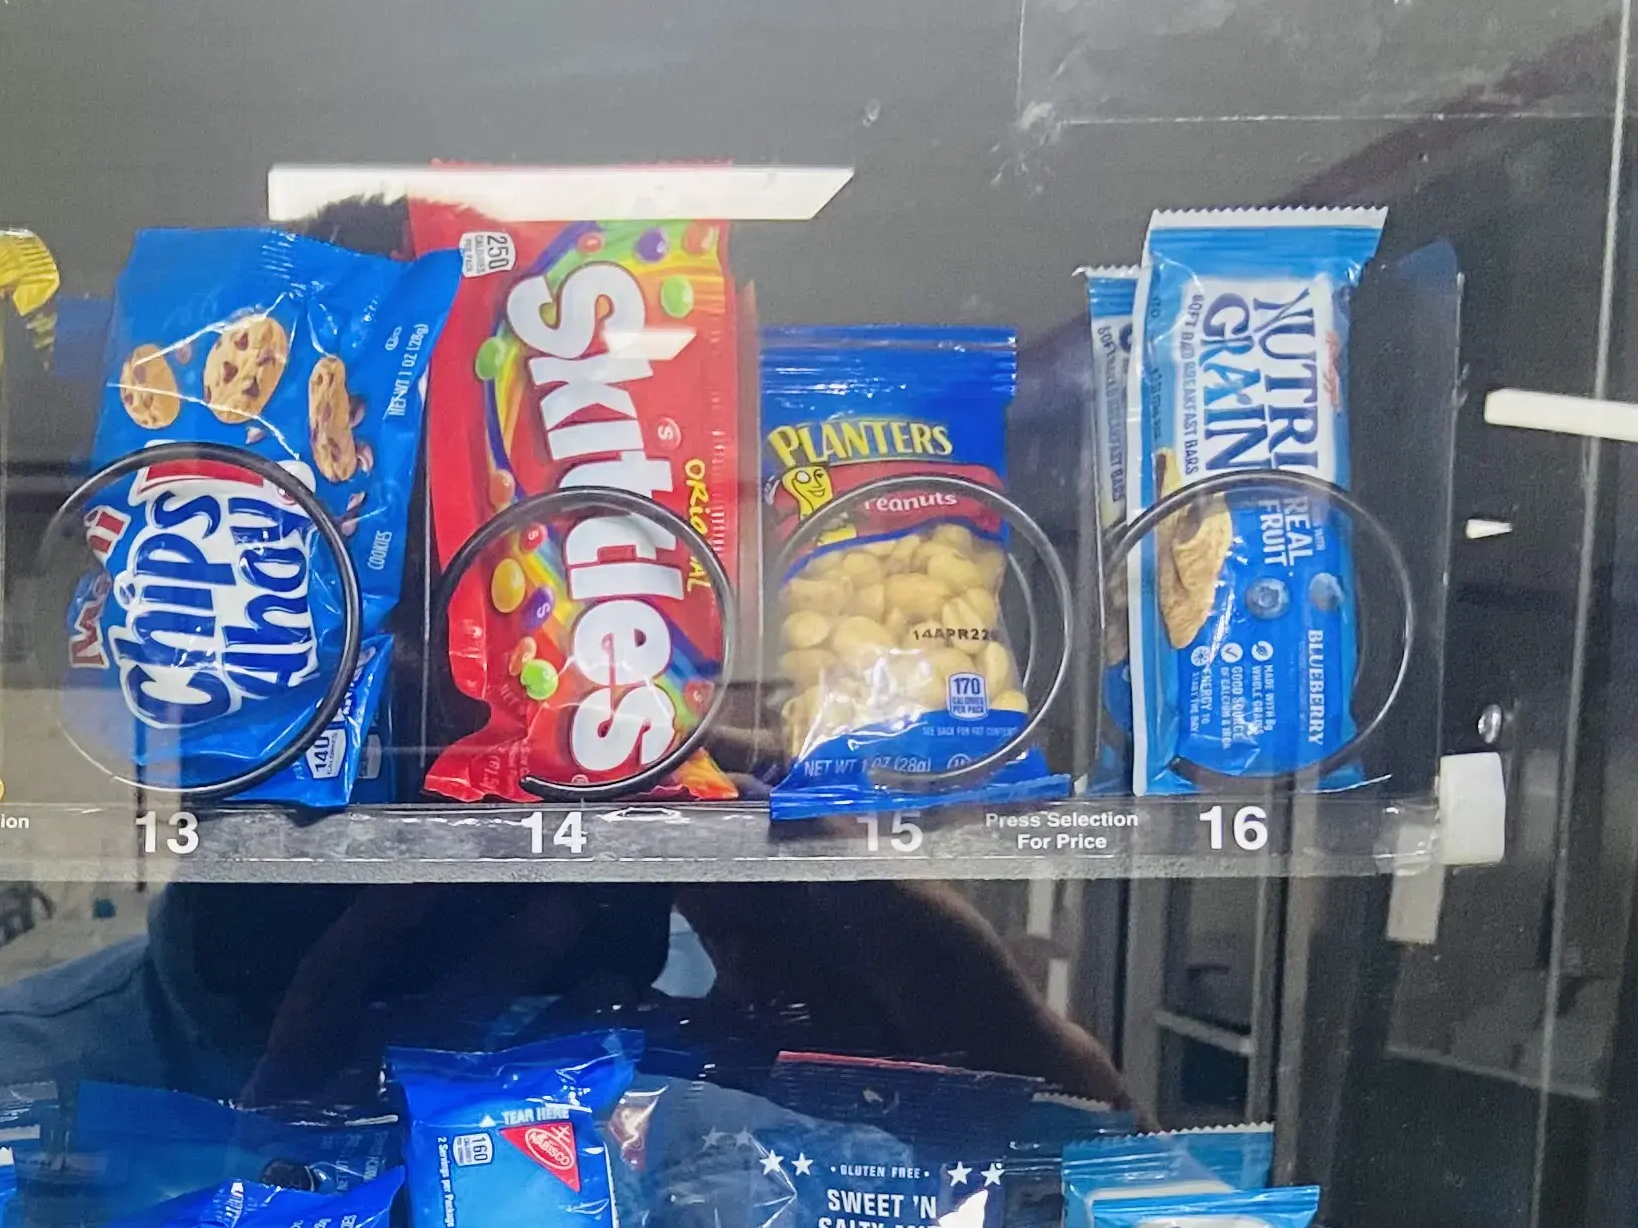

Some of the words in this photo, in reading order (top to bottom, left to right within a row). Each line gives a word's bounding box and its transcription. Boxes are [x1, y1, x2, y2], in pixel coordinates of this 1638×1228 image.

[486, 234, 510, 271] 250
[1189, 293, 1205, 328] SOFT
[1200, 292, 1273, 472] GRAIN
[1253, 288, 1320, 471] NUTRI
[768, 421, 954, 469] PLANTERS
[1184, 439, 1200, 476] BARS
[506, 261, 685, 772] Skittles
[1258, 499, 1288, 567] FRUIT
[1283, 496, 1314, 567] REAL
[366, 529, 395, 571] COOKIES
[953, 676, 981, 695] 170
[1308, 629, 1326, 746] BLUEBERRY
[804, 760, 833, 777] NET
[835, 759, 855, 775] WT
[135, 811, 200, 854] 13
[521, 811, 588, 854] 14
[858, 810, 924, 852] 15
[985, 813, 1042, 828] Press
[1047, 812, 1139, 829] Selection
[1017, 834, 1050, 849] For
[1053, 833, 1107, 850] Price
[1199, 806, 1268, 851] 16
[502, 1108, 535, 1126] TEAR
[472, 1136, 489, 1164] 160
[840, 1164, 886, 1178] GLUTEN
[891, 1166, 921, 1179] FREE
[826, 1188, 905, 1219] SWEET
